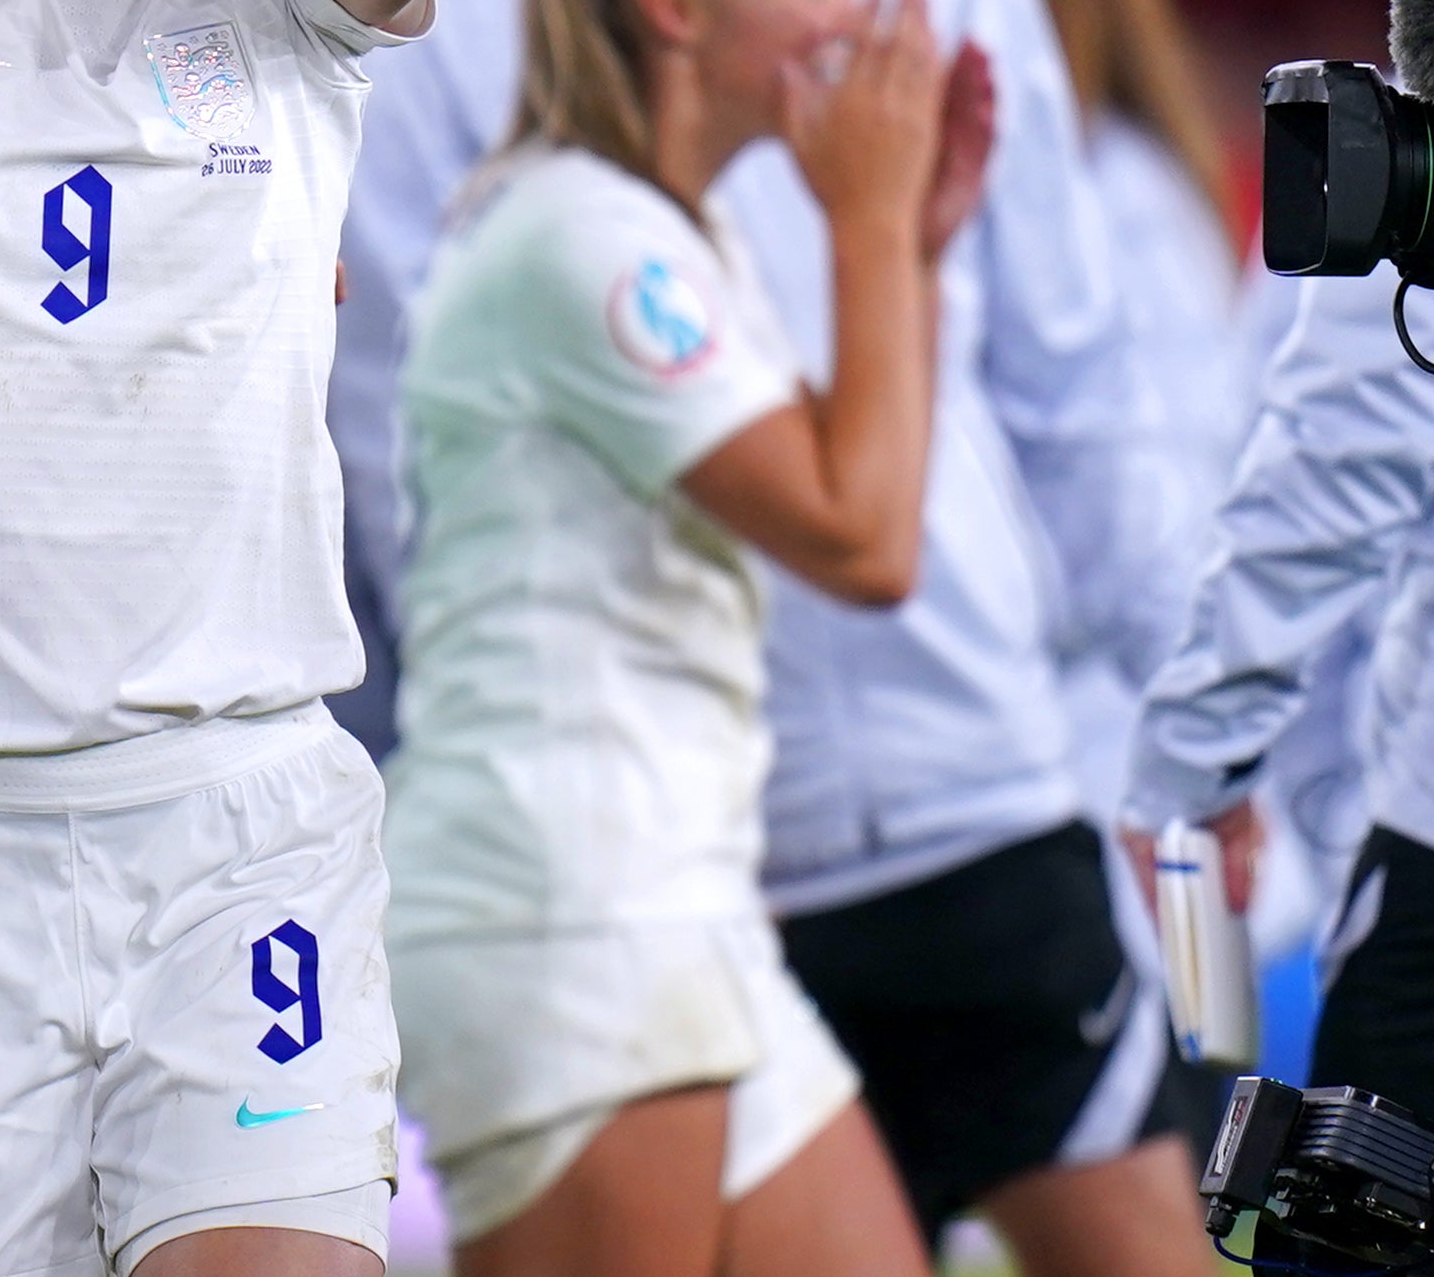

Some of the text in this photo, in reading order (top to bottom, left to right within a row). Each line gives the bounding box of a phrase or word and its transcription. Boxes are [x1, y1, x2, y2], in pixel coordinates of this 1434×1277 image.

[201, 159, 272, 177] 26 JULY 2022
[209, 142, 261, 158] SWEDEN
[40, 164, 112, 325] 9
[250, 918, 322, 1065] 9
